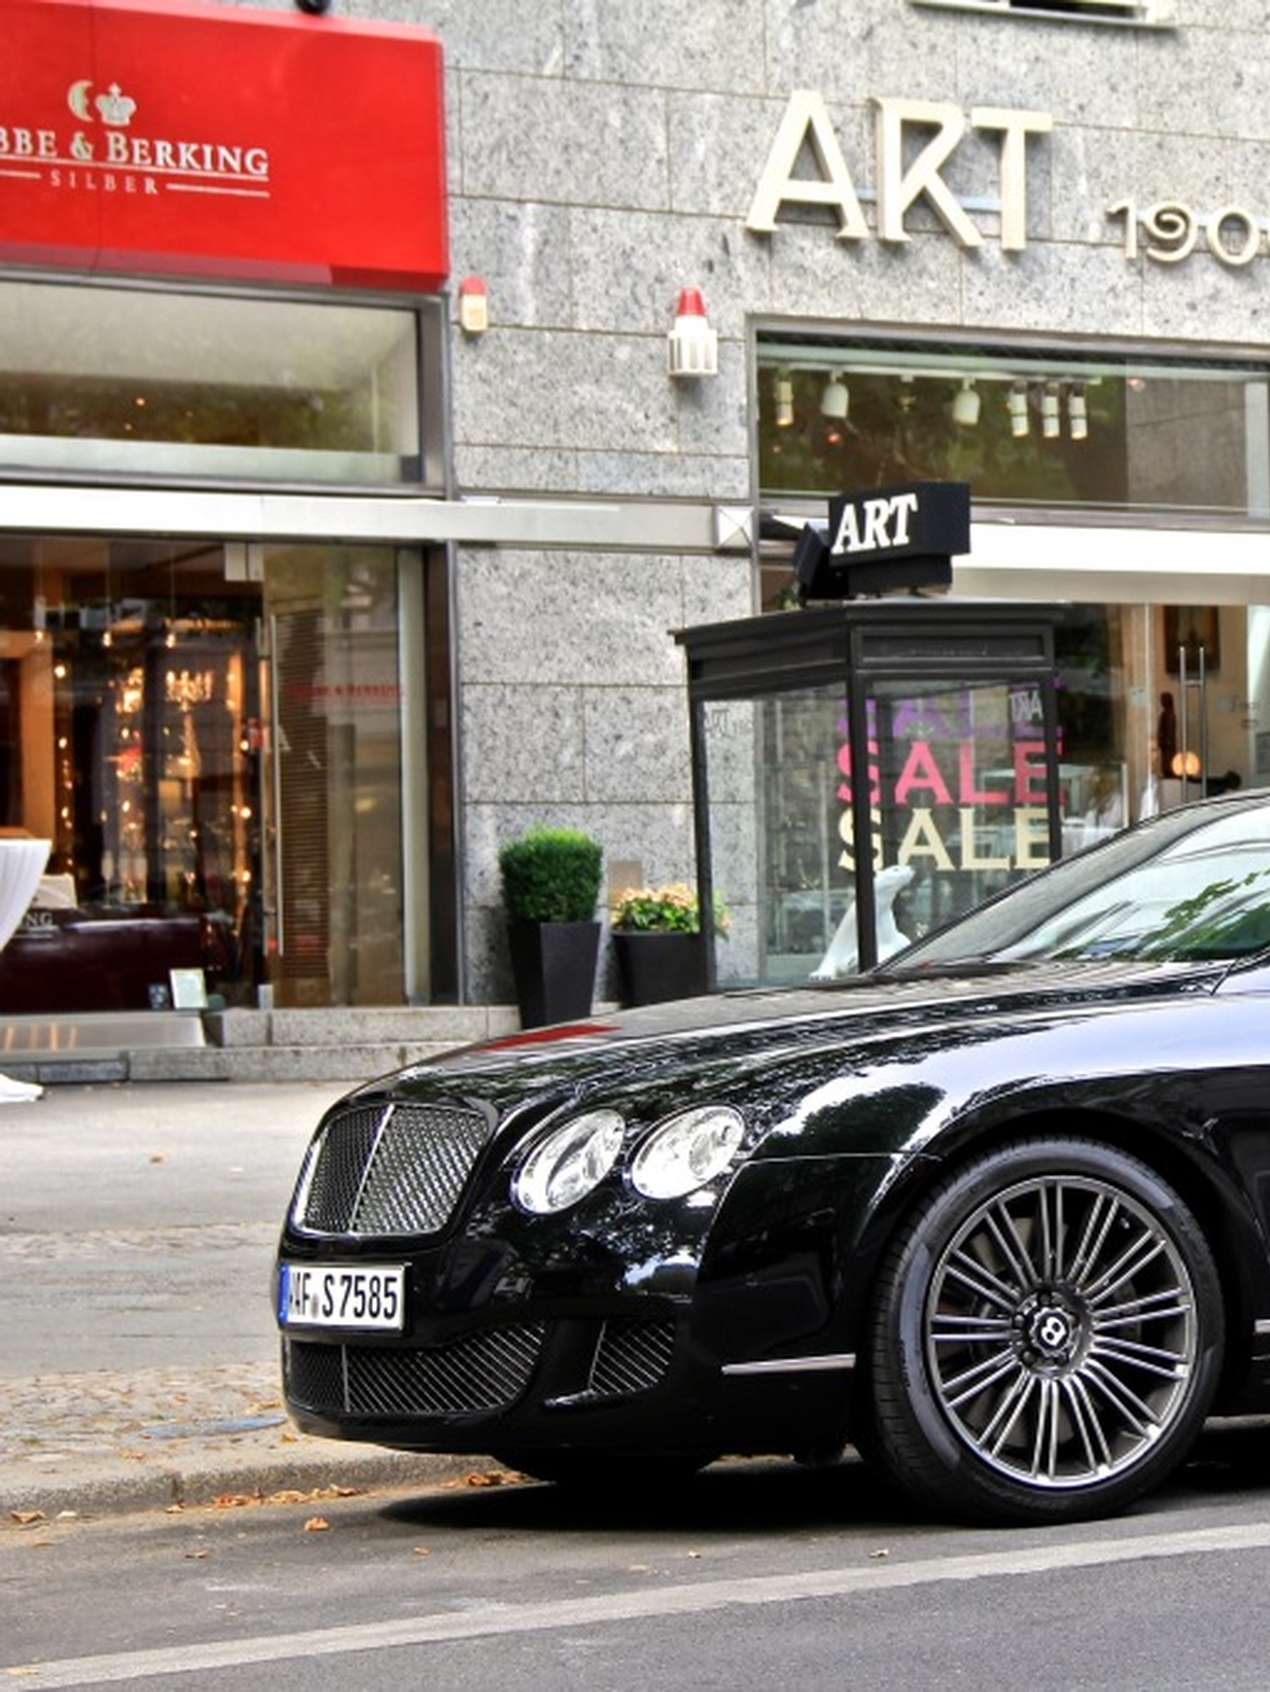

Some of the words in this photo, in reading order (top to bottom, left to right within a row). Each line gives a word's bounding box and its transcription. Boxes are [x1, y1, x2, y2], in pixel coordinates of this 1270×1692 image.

[51, 169, 158, 195] SILBER
[70, 131, 94, 161] &
[105, 131, 269, 176] BERKING
[744, 90, 1052, 252] ART
[830, 493, 919, 555] ART
[836, 740, 1067, 805] SALE
[838, 807, 1067, 872] SALE
